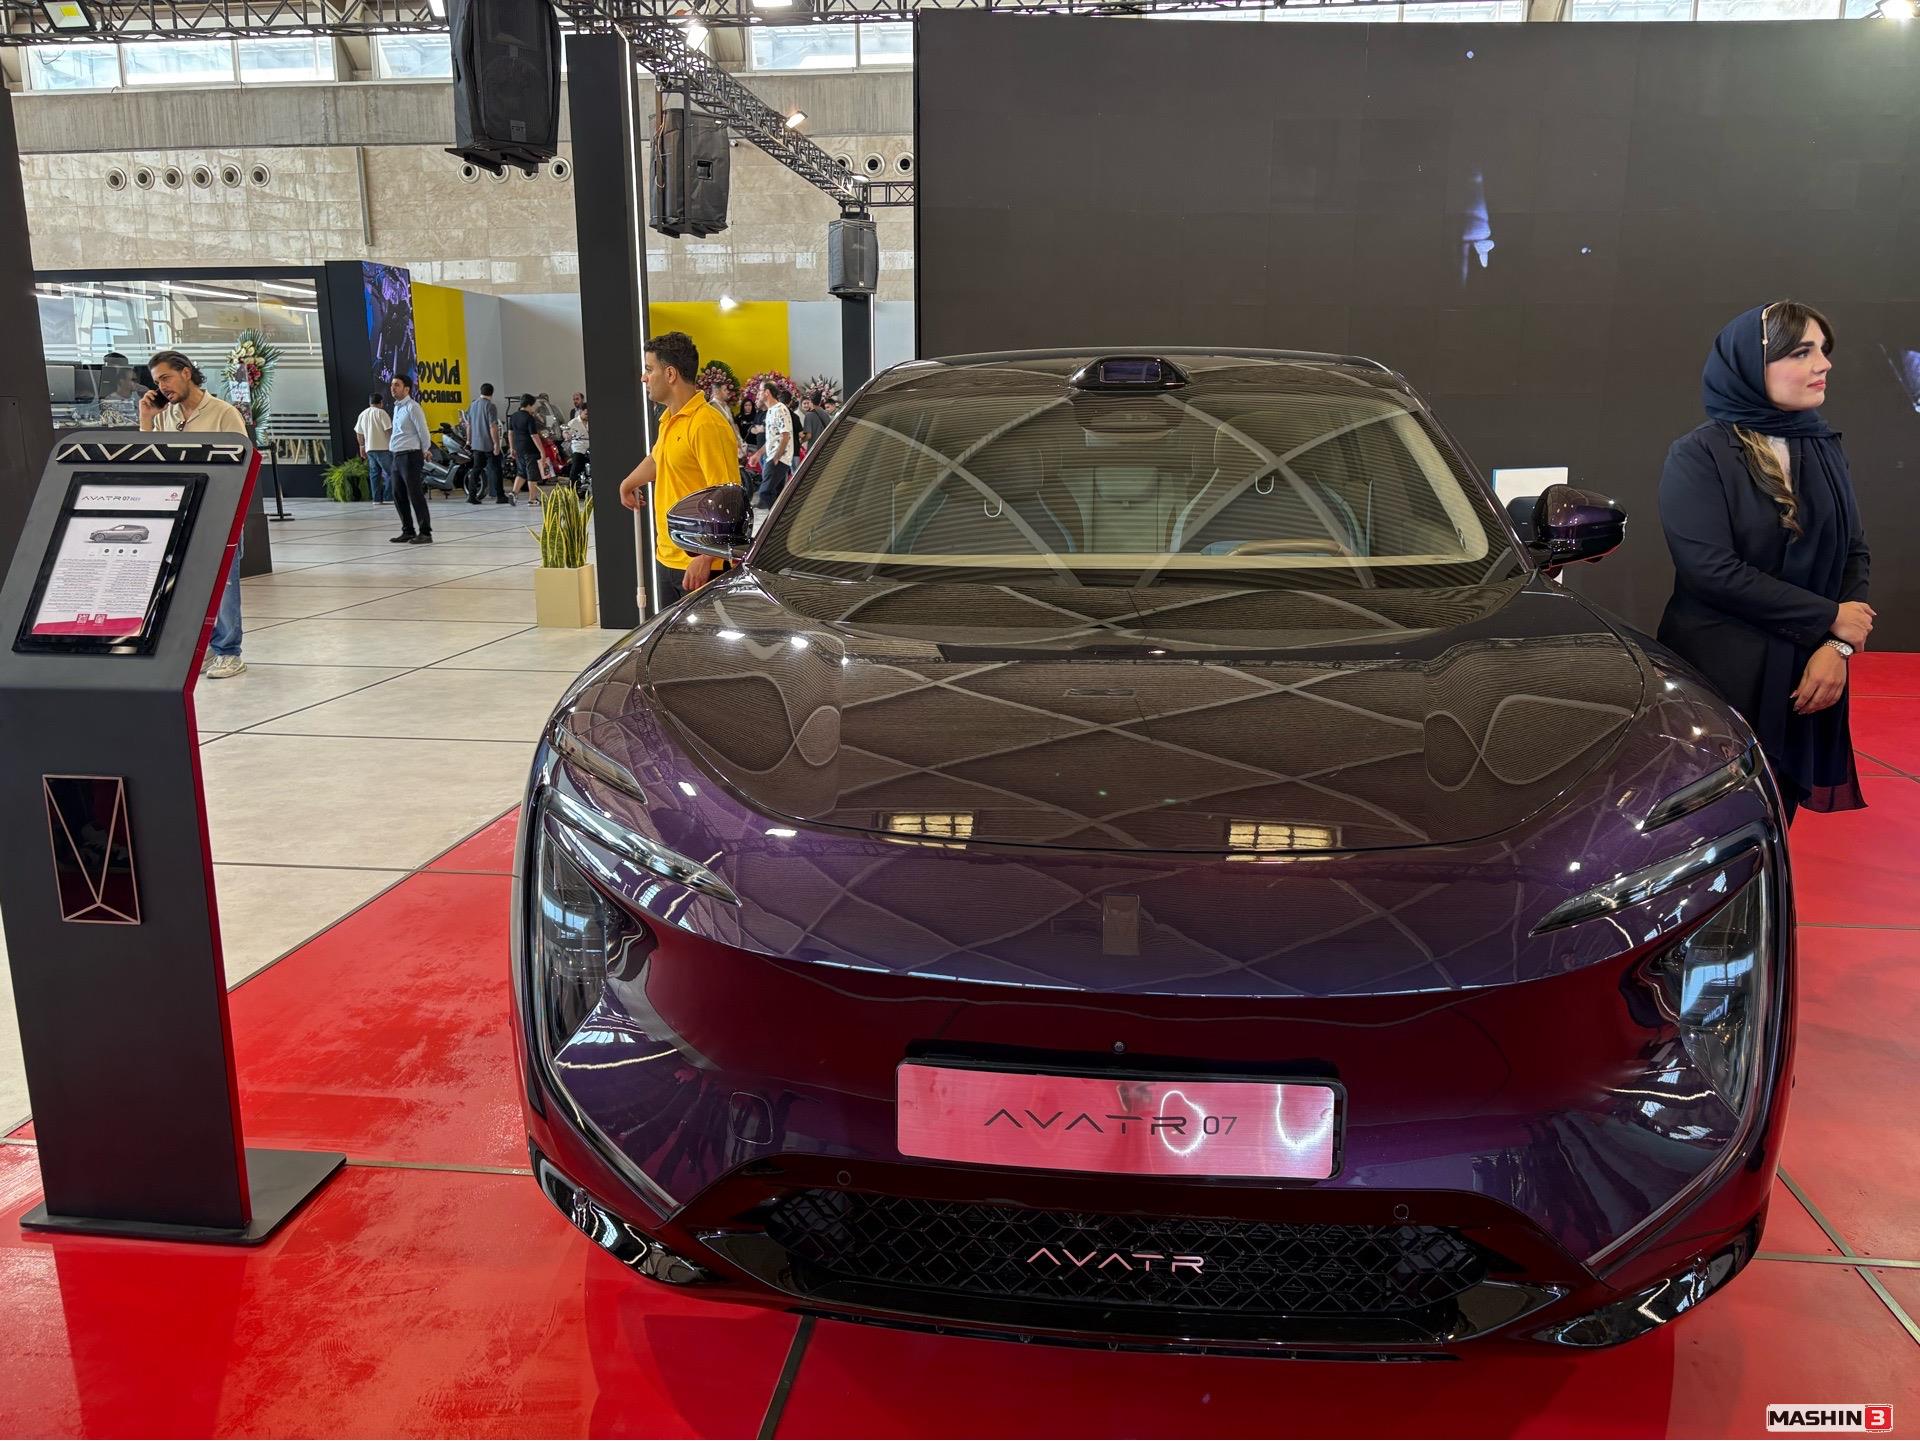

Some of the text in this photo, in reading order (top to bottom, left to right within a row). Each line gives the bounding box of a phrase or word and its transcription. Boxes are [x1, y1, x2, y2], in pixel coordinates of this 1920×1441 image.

[56, 443, 244, 462] AVATR
[984, 1108, 1238, 1135] AVATR 07
[1027, 1247, 1205, 1274] AVATR
